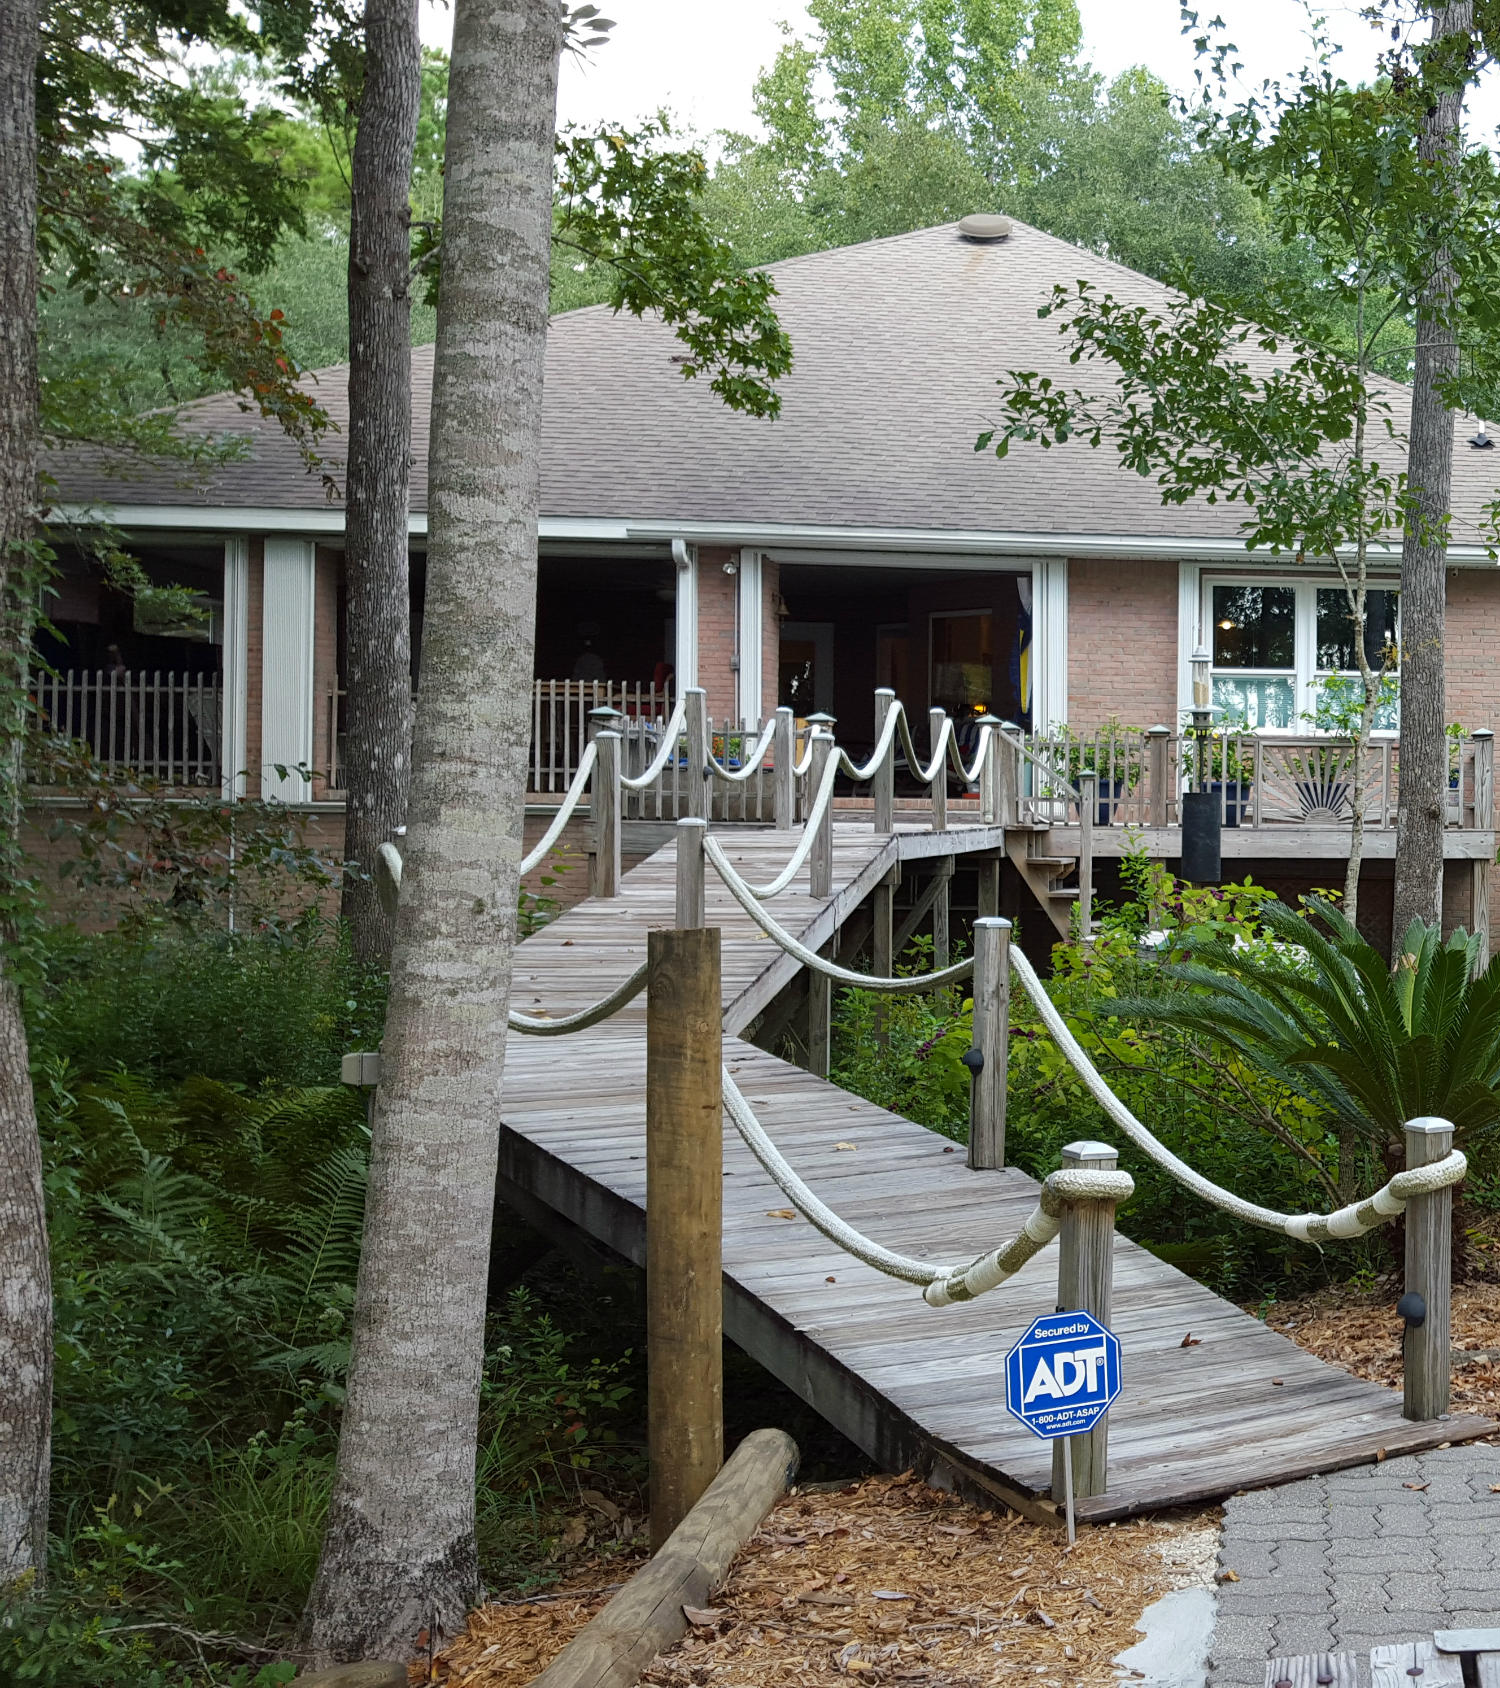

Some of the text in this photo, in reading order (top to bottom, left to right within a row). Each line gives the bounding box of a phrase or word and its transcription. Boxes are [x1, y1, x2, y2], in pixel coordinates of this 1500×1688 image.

[1034, 1323, 1090, 1339] Secured by
[1024, 1346, 1105, 1404] ADT
[1031, 1406, 1100, 1425] 1-800-ADT-ASAP
[1046, 1418, 1086, 1430] www.adt.com
